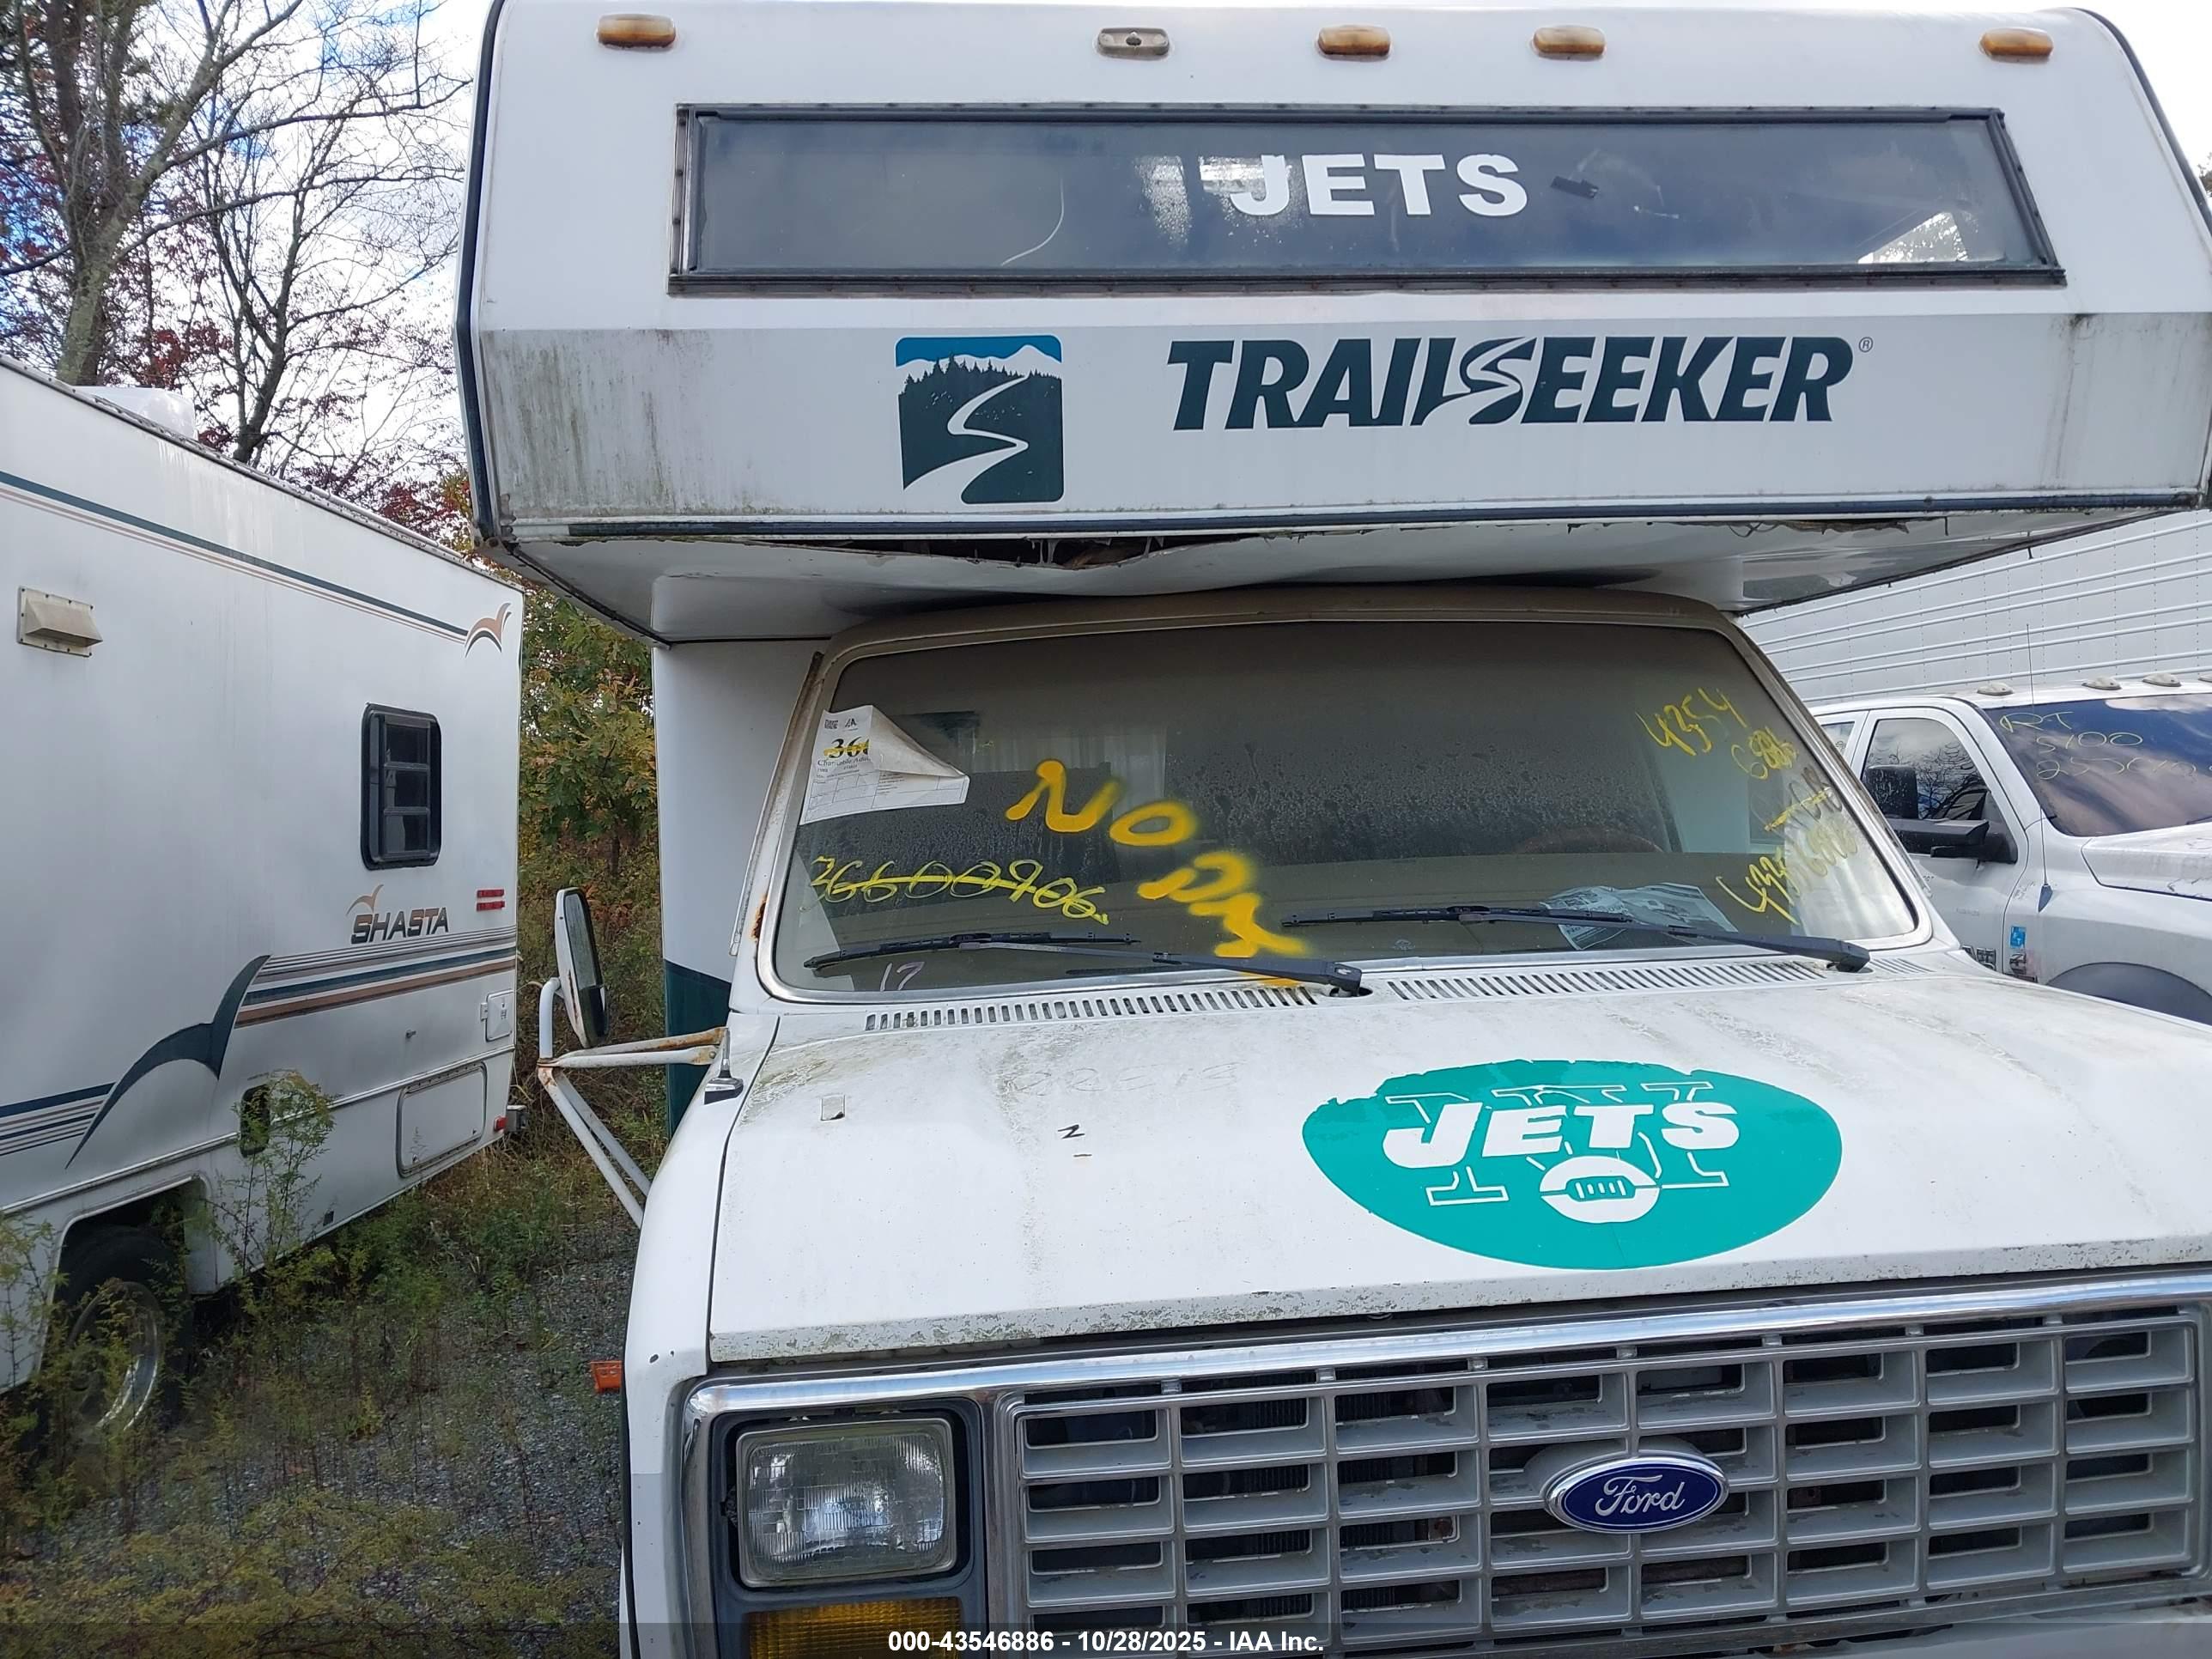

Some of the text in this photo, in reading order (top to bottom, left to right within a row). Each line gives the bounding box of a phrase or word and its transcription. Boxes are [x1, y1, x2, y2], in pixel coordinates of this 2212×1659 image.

[1230, 153, 1528, 216] JETS
[1166, 336, 1853, 431] TRAILSEEKER
[350, 907, 450, 945] SHASTA
[1382, 1101, 1741, 1169] JETS
[1594, 1474, 1686, 1517] Ford
